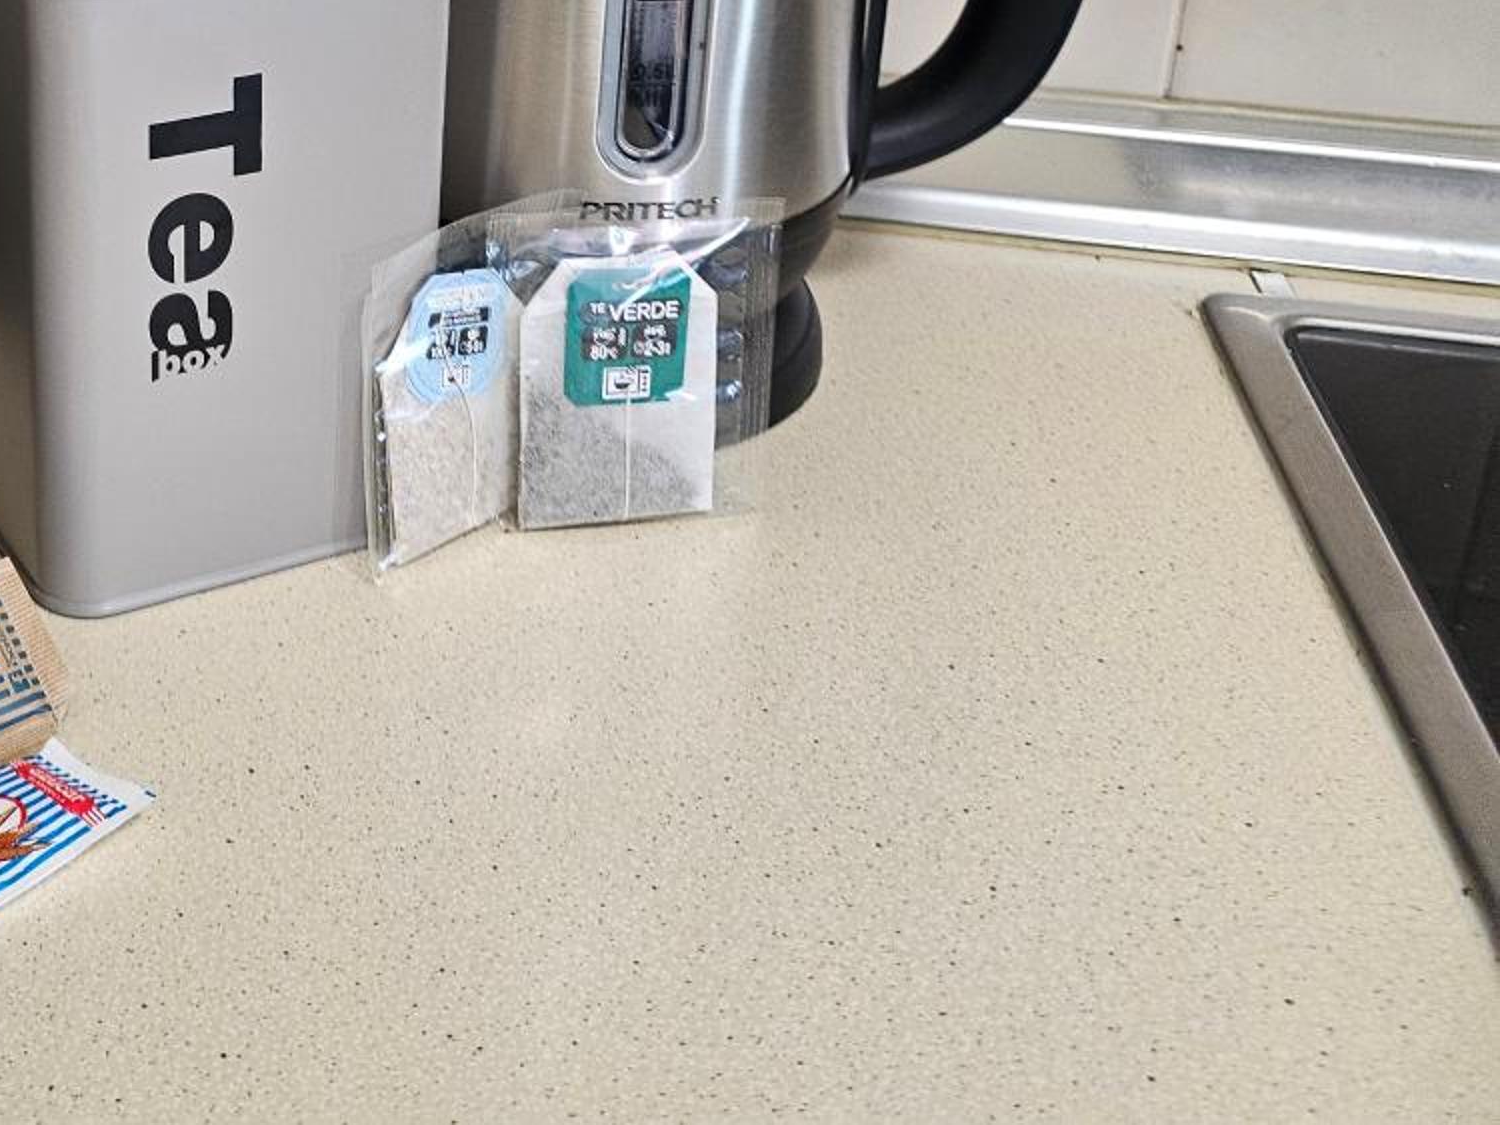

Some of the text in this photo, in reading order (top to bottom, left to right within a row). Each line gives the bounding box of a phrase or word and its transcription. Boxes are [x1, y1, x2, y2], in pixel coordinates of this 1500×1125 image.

[578, 196, 718, 223] PRITECH
[148, 72, 263, 383] Tea
[609, 300, 680, 322] VERDE
[159, 343, 227, 376] box
